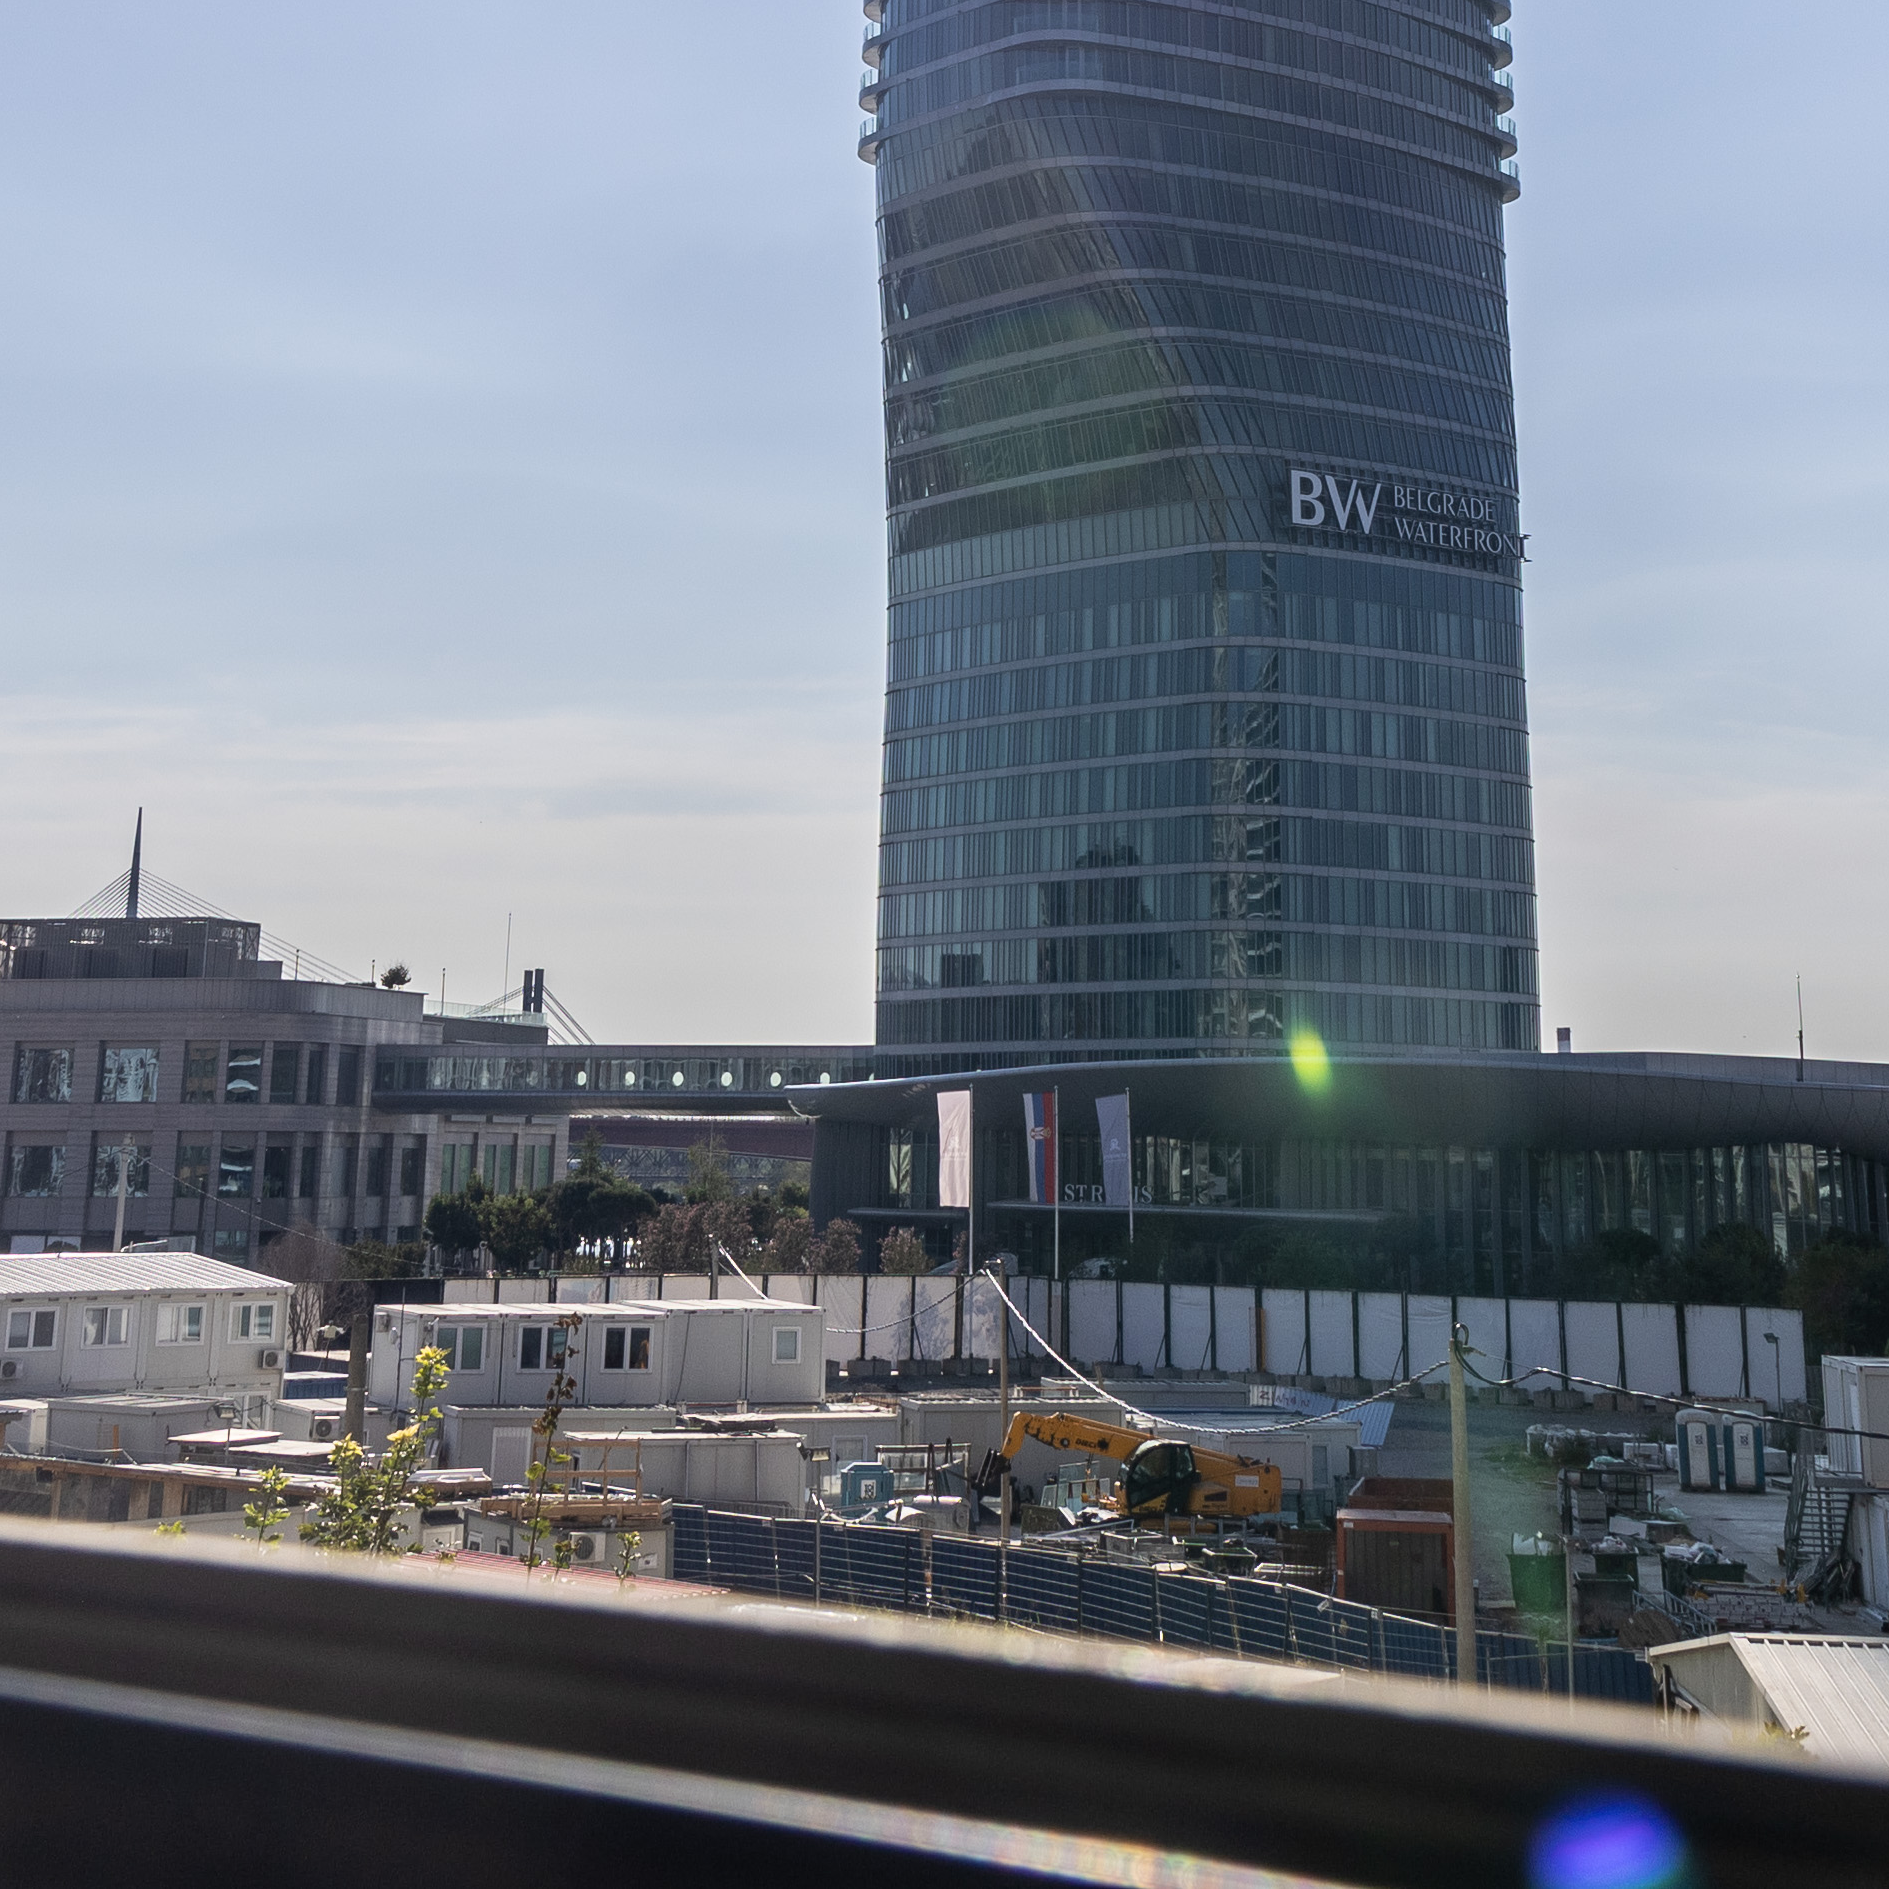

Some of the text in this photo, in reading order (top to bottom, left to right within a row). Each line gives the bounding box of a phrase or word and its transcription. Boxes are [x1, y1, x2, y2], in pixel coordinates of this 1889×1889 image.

[1290, 469, 1382, 535] BW
[1393, 485, 1496, 523] BELGRADE
[1393, 517, 1522, 557] WATERFRON
[1090, 1184, 1153, 1204] RIS
